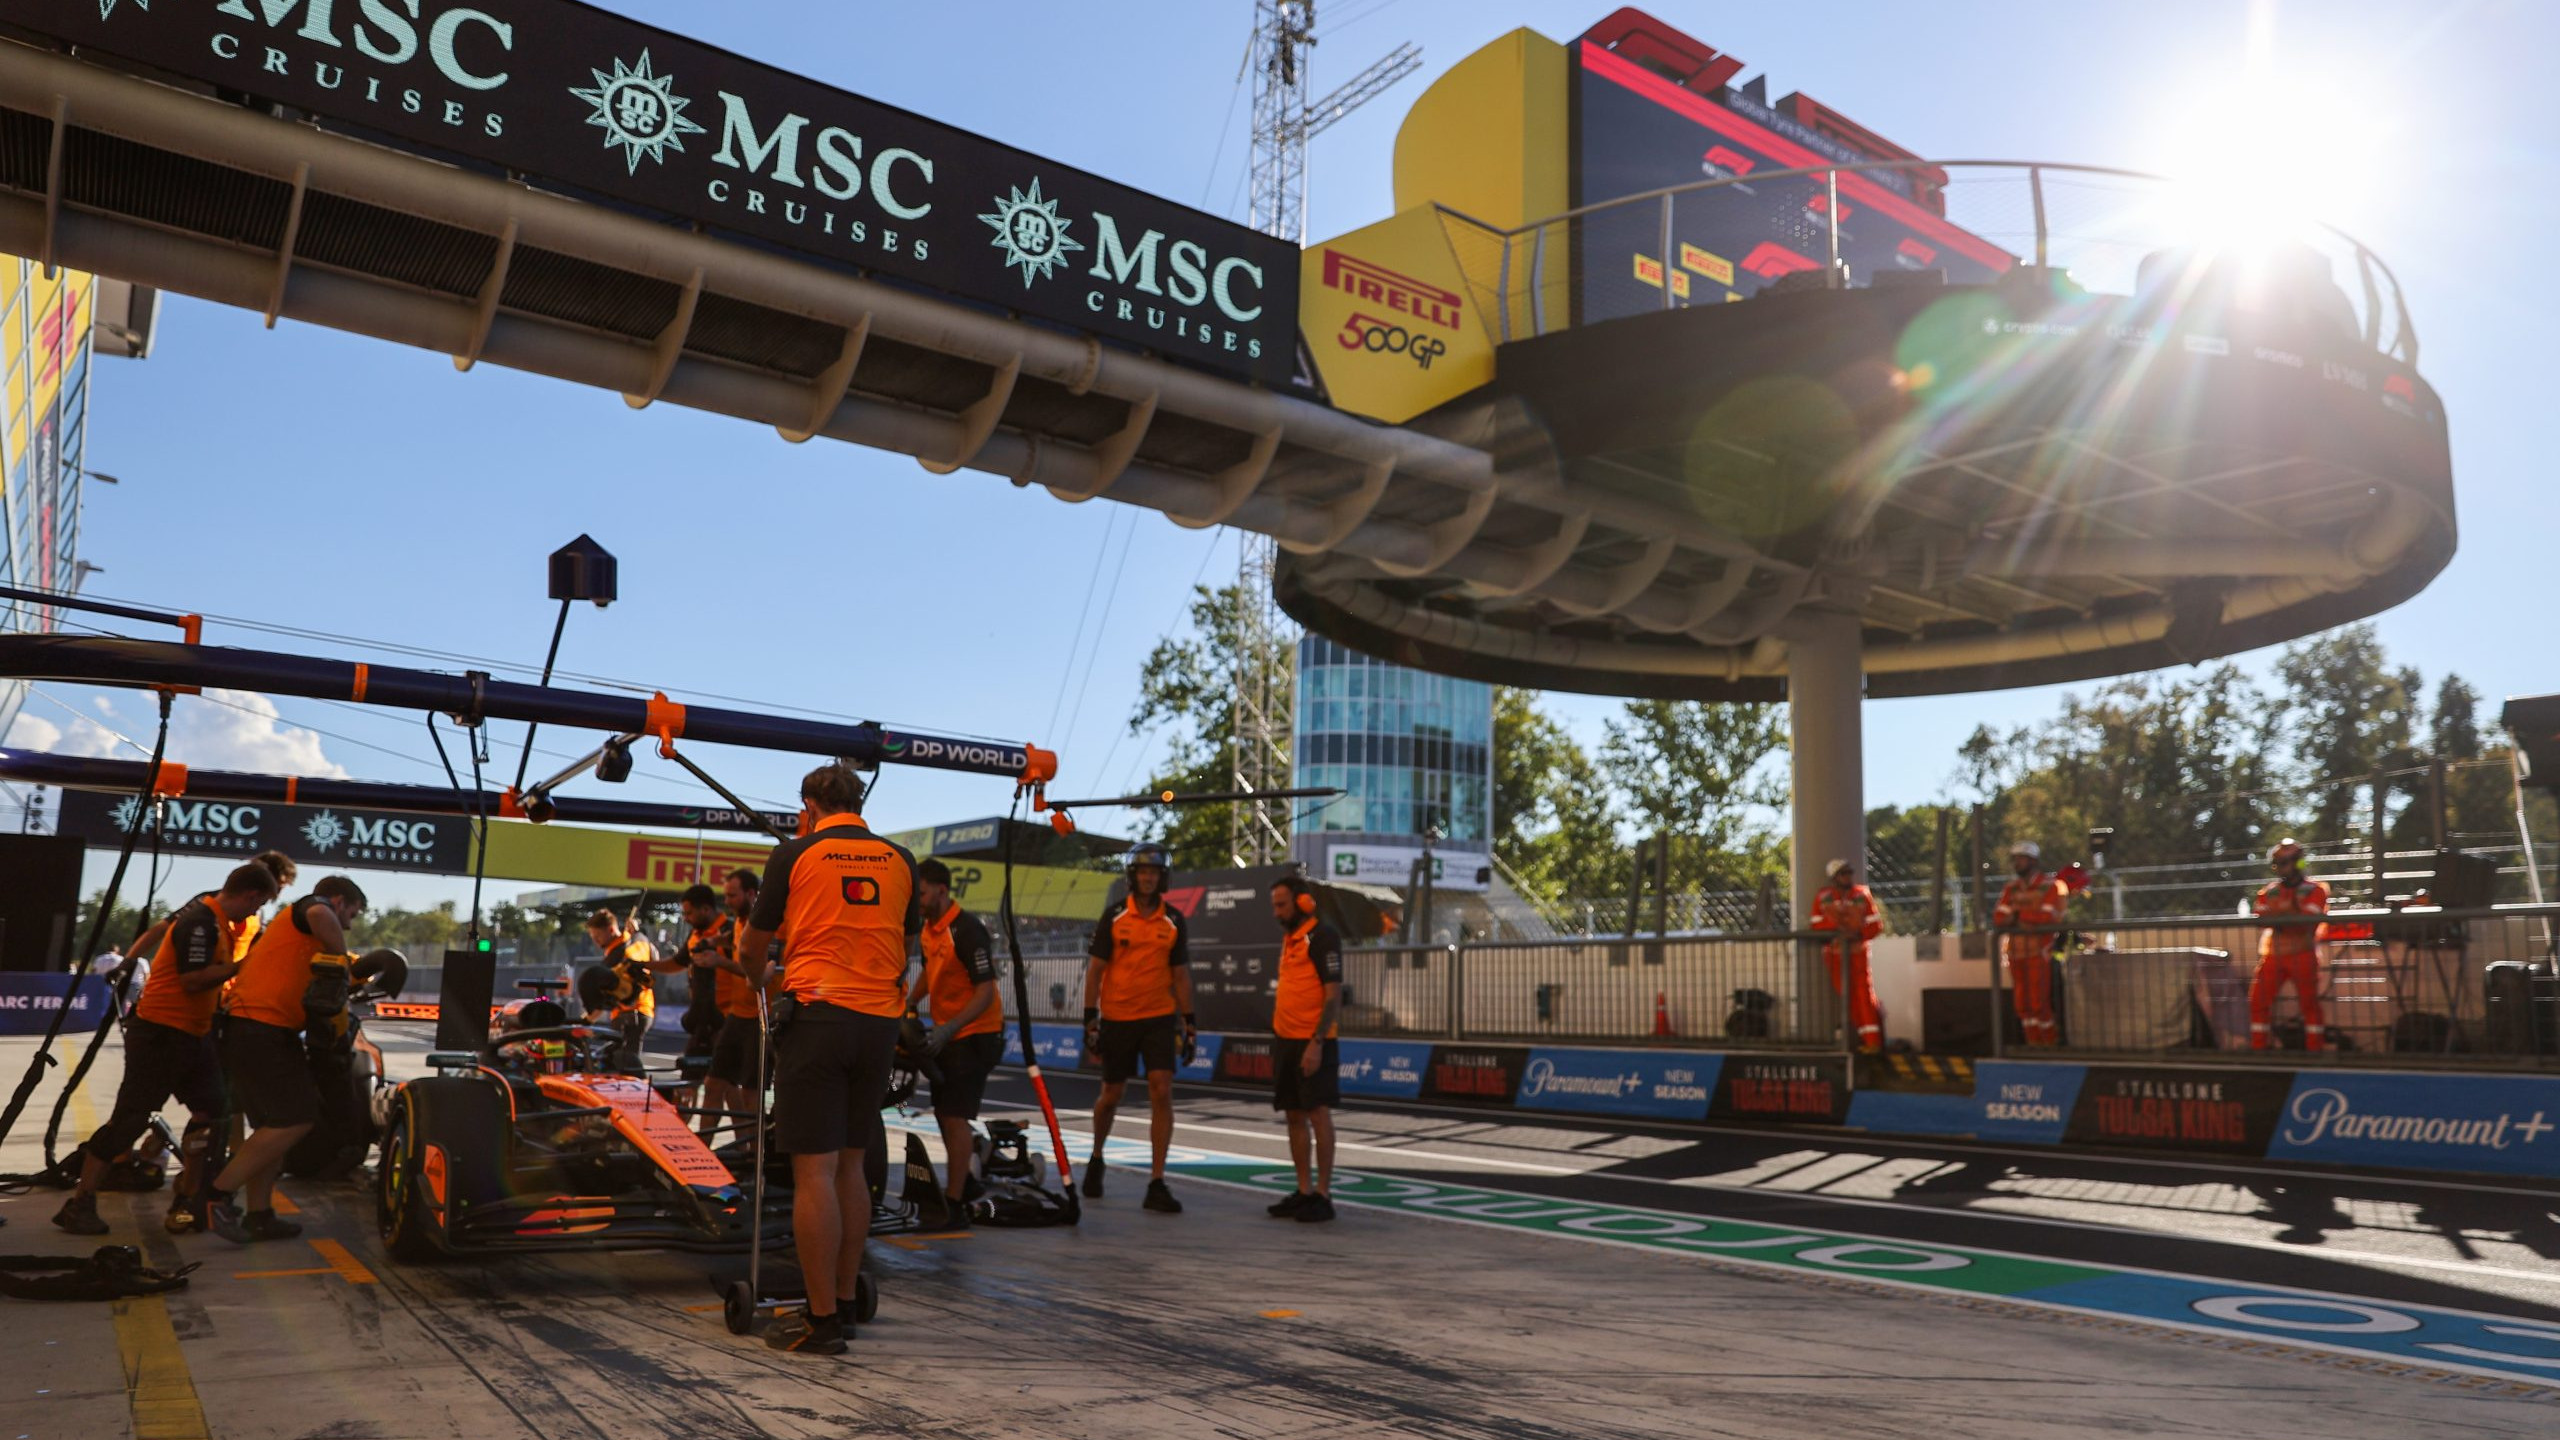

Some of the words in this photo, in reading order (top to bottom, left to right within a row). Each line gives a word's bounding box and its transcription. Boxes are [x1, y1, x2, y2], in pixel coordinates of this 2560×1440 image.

[211, 33, 504, 137] CRUISES
[711, 90, 935, 220] MSC
[708, 179, 929, 261] CRUISES
[1088, 211, 1264, 322] MSC
[1322, 248, 1463, 331] PIRELLI
[1086, 291, 1262, 359] CRUISES
[911, 739, 945, 758] DP
[947, 744, 1027, 769] WORLD
[165, 801, 261, 836] MSC
[350, 816, 436, 851] MSC
[706, 810, 731, 823] DP
[734, 811, 799, 827] WRLD
[949, 824, 995, 843] ZERO
[162, 832, 258, 850] CRUISES
[347, 847, 433, 864] CRUISES
[822, 852, 888, 862] McLaren
[1522, 1058, 1642, 1098] Paramount+
[1665, 1069, 1695, 1083] NEW
[2117, 1080, 2223, 1101] STALLONE
[1654, 1085, 1707, 1100] SEASON
[2002, 1084, 2043, 1101] NEW
[1985, 1103, 2060, 1122] SEASON
[2097, 1095, 2176, 1137] TULSA
[2181, 1100, 2245, 1141] KING
[2284, 1087, 2555, 1149] Paramount+
